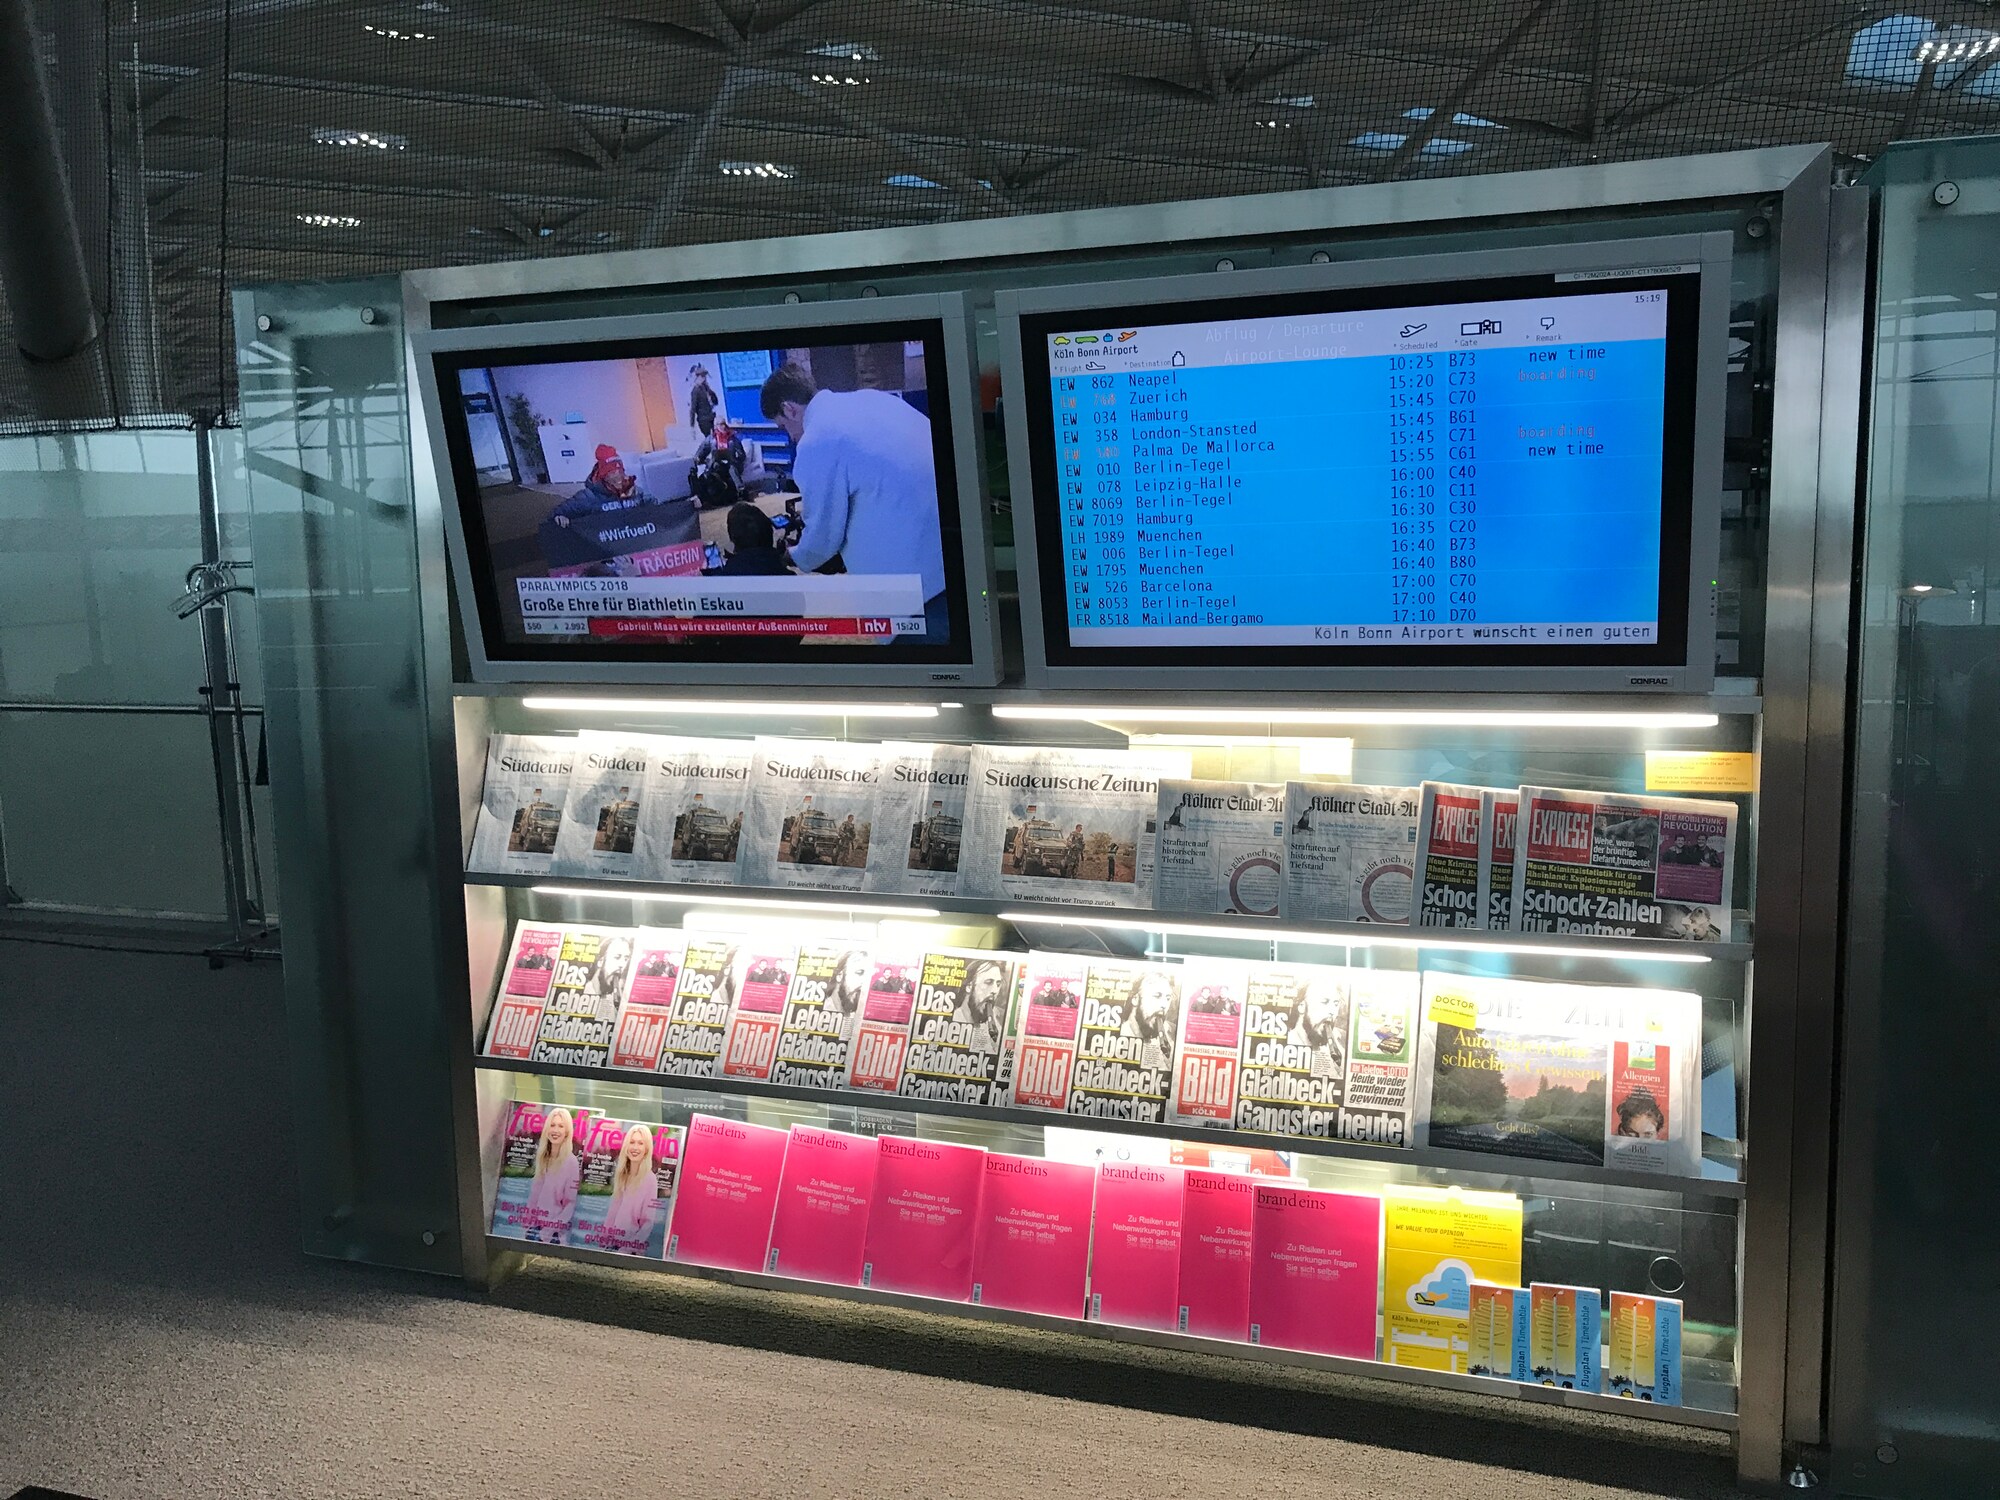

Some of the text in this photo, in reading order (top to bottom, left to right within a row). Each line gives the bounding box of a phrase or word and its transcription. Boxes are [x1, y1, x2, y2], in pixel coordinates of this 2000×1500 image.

[1635, 294, 1660, 303] 15:19
[1205, 328, 1257, 342] Abflug
[1284, 321, 1364, 338] Departure
[1400, 334, 1562, 350] Scheduled Gate Remark
[1054, 345, 1138, 359] Köln Bonn Airport
[1225, 345, 1346, 363] Airport-Lounge
[1059, 359, 1171, 373] Flight Destination
[1060, 347, 1606, 390] EW 862 Neapel 10:25 B73 new time
[1130, 367, 1596, 405] Zuerich 15:20 C73 boarding
[1064, 410, 1476, 443] EW 358 London-Stansted 15:45 B61
[1134, 425, 1595, 458] Palma De Mallorca 15:45 C71 boarding
[1066, 441, 1604, 477] EW 010 Berlin-Tegel 15:55 C61 new time
[599, 522, 656, 542] #WirfuerD
[1071, 520, 1476, 544] LH 1989 Muenchen 16:35 C20
[521, 581, 628, 591] PARALYMPICS 2018
[524, 598, 743, 611] Große Ehre für Biathletin Eskau
[1077, 609, 1476, 626] FR 8518 Mailand-Bergamo 17:10 D70
[618, 622, 652, 631] Gabriel:
[655, 623, 678, 631] Maas
[681, 622, 703, 631] wäre
[706, 623, 756, 631] exzellenter
[759, 622, 827, 631] Außenminister
[865, 621, 886, 632] ntv
[896, 622, 919, 630] 15:20
[1315, 626, 1650, 641] Köln Bonn Airport wünscht einen guten
[1631, 677, 1667, 685] CONRAC
[766, 761, 872, 784] Süddeutsche
[985, 768, 1100, 791] Süddeutsche
[1180, 793, 1224, 809] Kölner
[1532, 809, 1589, 849] EXPRESS
[1663, 821, 1724, 833] REVOLUTION
[1163, 839, 1196, 847] Straftaten
[1594, 837, 1614, 846] Wehe,
[1162, 847, 1205, 856] historischem
[1231, 849, 1266, 870] gibt noch
[1605, 847, 1637, 857] brünftige
[1161, 856, 1193, 864] Tiefstand
[1593, 854, 1650, 867] Elefant trompetet
[1024, 894, 1044, 902] weicht
[1074, 897, 1093, 905] Trump
[1095, 898, 1116, 906] zurück
[1523, 889, 1661, 924] Schock-Zahlen
[923, 975, 962, 987] ARD-Film
[1436, 996, 1475, 1009] DOCTOR
[495, 1007, 538, 1047] Bild
[1247, 1005, 1288, 1035] Das
[855, 1033, 903, 1078] Bild
[1244, 1036, 1312, 1070] Leben
[1184, 1058, 1232, 1105] Bild
[1351, 1074, 1406, 1086] Heute wieder
[1622, 1071, 1660, 1083] Allergien
[1240, 1068, 1341, 1104] Gladbeck-
[1351, 1084, 1405, 1097] anrufen und
[1349, 1095, 1404, 1107] gewinnen!
[1192, 1108, 1216, 1116] KÖLN
[1237, 1100, 1403, 1144] Gangster heute
[579, 1221, 625, 1236] Bin ich eine
[1440, 1229, 1464, 1237] OPINION
[585, 1233, 649, 1249] gute Freundin?
[1299, 1245, 1325, 1254] Risiken
[1271, 1252, 1357, 1268] Nebenwirkungen fragen
[1318, 1268, 1338, 1276] selbst
[1660, 1317, 1670, 1356] Timetable
[1660, 1364, 1671, 1400] Flugplan
